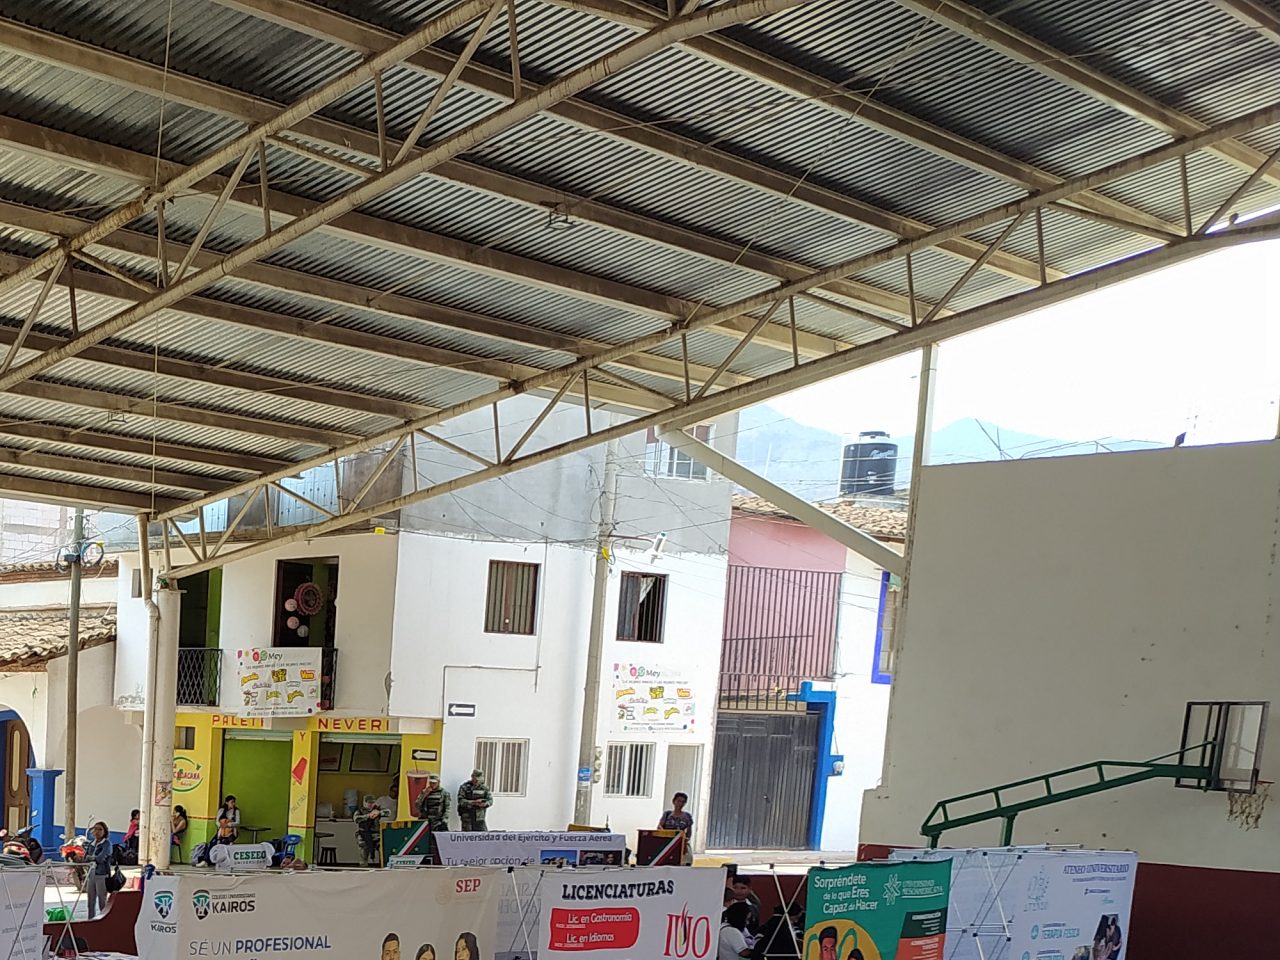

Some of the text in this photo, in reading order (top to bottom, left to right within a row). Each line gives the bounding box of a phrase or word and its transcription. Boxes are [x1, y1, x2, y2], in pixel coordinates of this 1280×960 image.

[450, 833, 501, 842] Universidad
[503, 833, 516, 841] del
[559, 834, 587, 842] Fuerza
[233, 850, 267, 861] CESEEO
[524, 856, 535, 865] de
[455, 878, 481, 893] SEP
[814, 873, 867, 890] Sorpréndete
[562, 879, 674, 900] LICENCIATURAS
[823, 892, 831, 900] de
[838, 891, 851, 900] que
[851, 886, 870, 899] Eres
[823, 901, 848, 916] Capaz
[855, 899, 878, 911] Hacer
[581, 915, 589, 923] en
[590, 911, 633, 923] Gastronomía
[579, 935, 589, 943] en
[588, 932, 615, 943] Idiomas
[189, 936, 332, 956] SÉ UN PROFESIONAL
